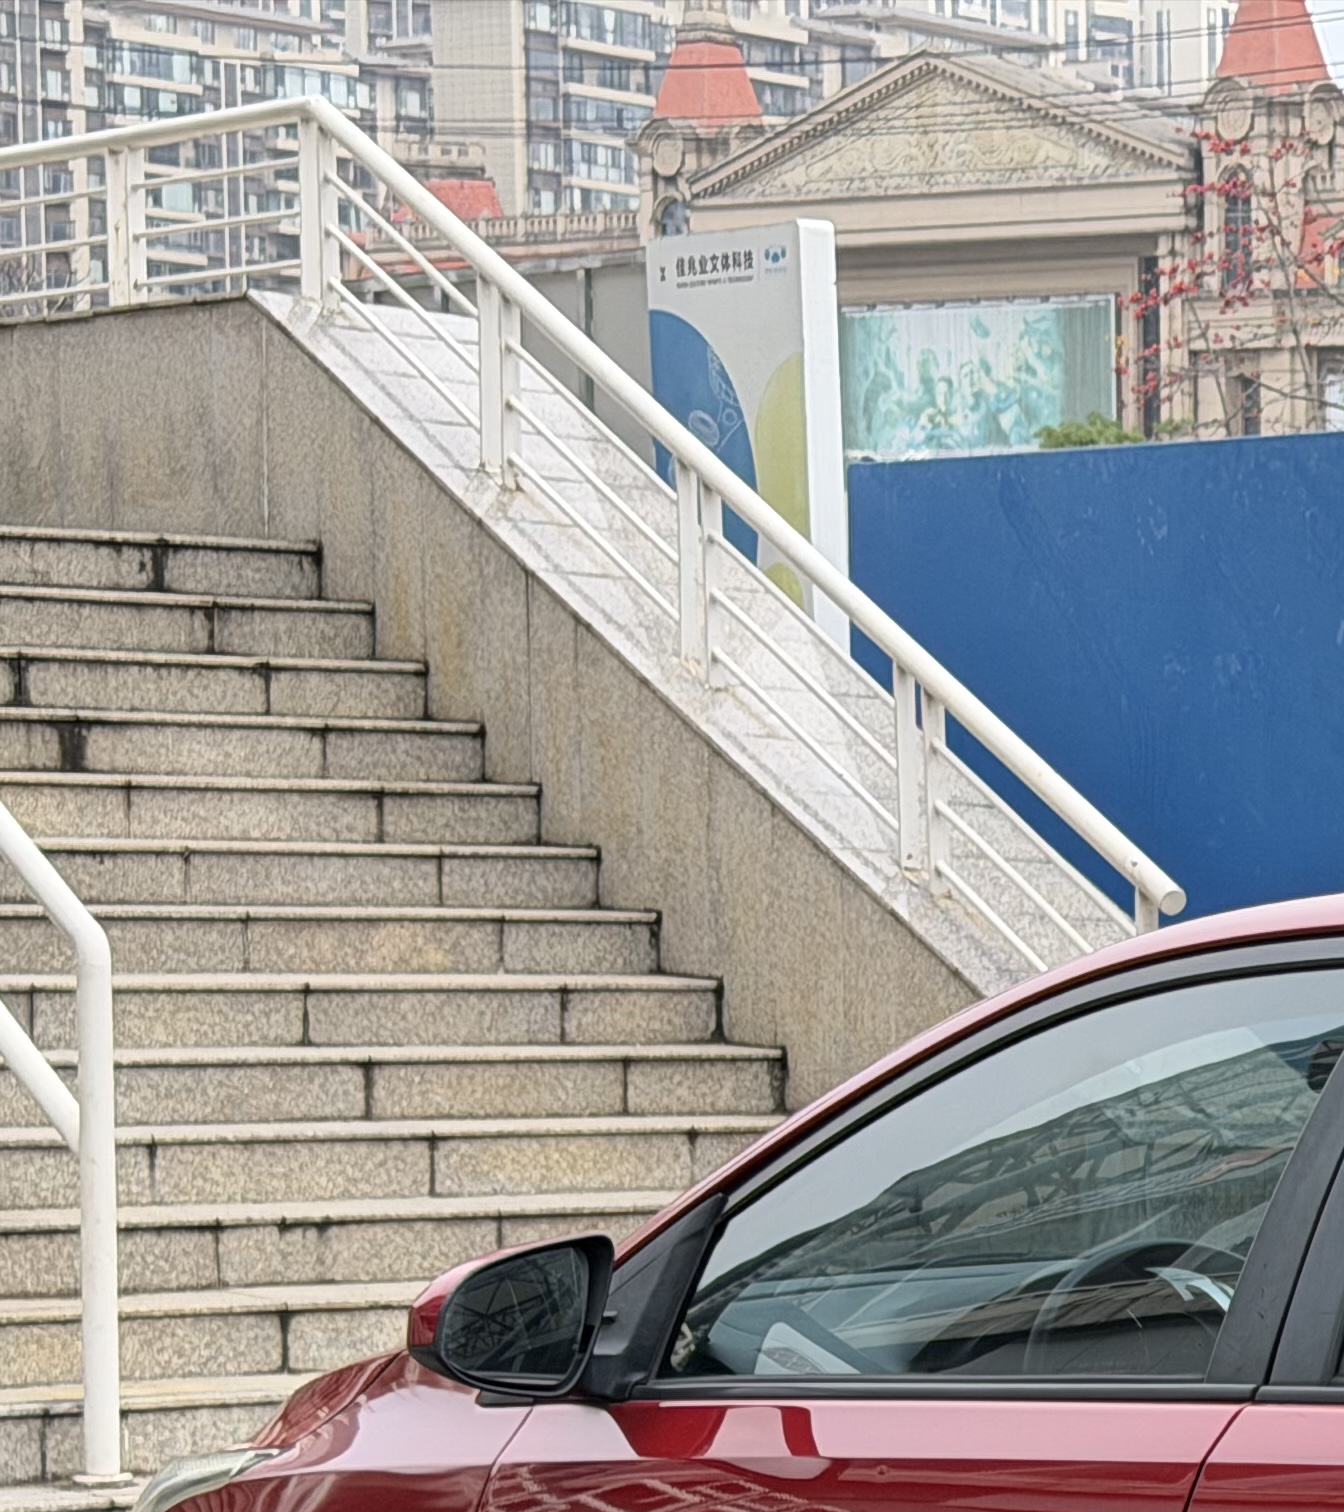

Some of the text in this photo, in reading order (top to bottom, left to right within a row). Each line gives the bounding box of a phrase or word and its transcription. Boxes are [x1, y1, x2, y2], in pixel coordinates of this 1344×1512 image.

[676, 249, 754, 277] 佳兆业文体科技
